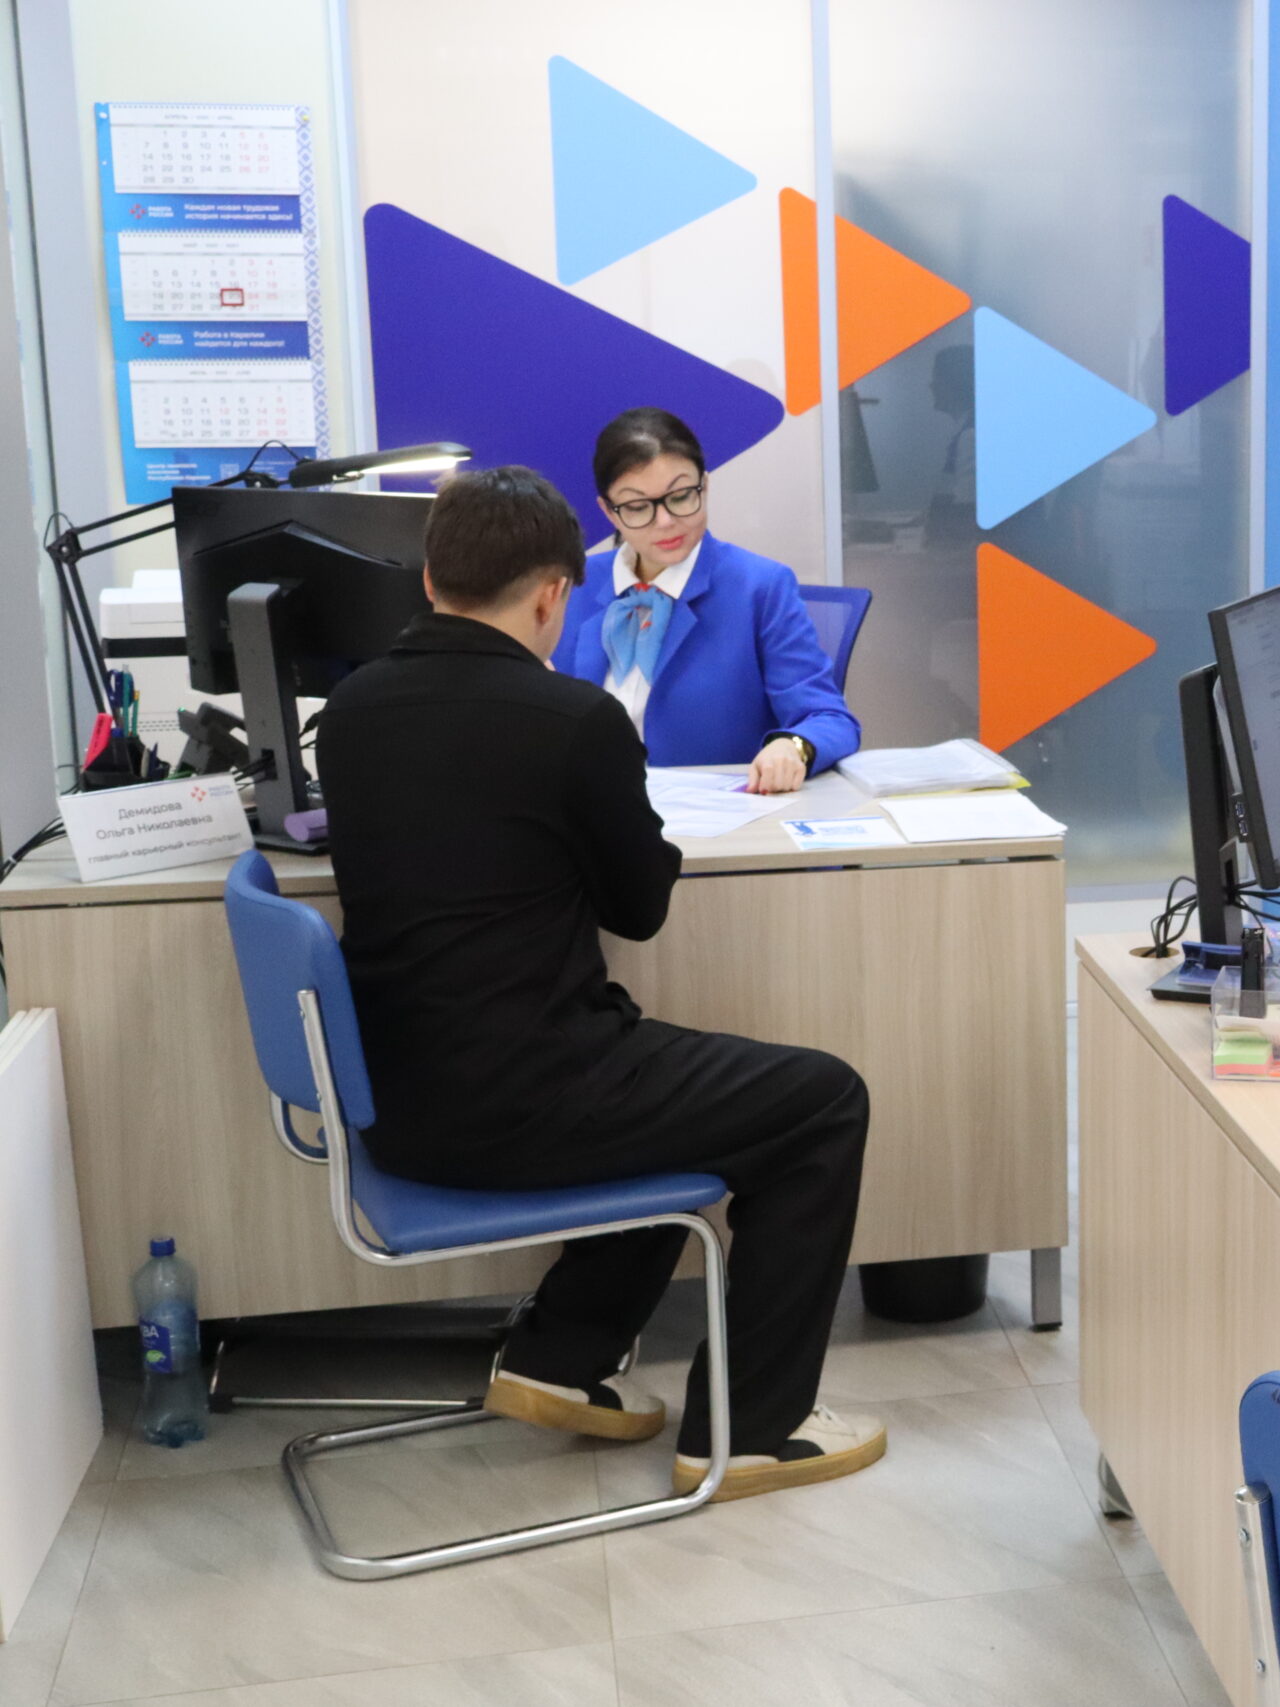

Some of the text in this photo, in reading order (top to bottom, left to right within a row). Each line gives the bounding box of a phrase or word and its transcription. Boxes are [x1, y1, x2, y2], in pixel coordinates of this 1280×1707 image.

[193, 331, 222, 339] Работа
[118, 801, 183, 821] Демидова
[96, 814, 213, 840] Ольга Николаевна
[88, 832, 242, 864] главный карьерный консультант
